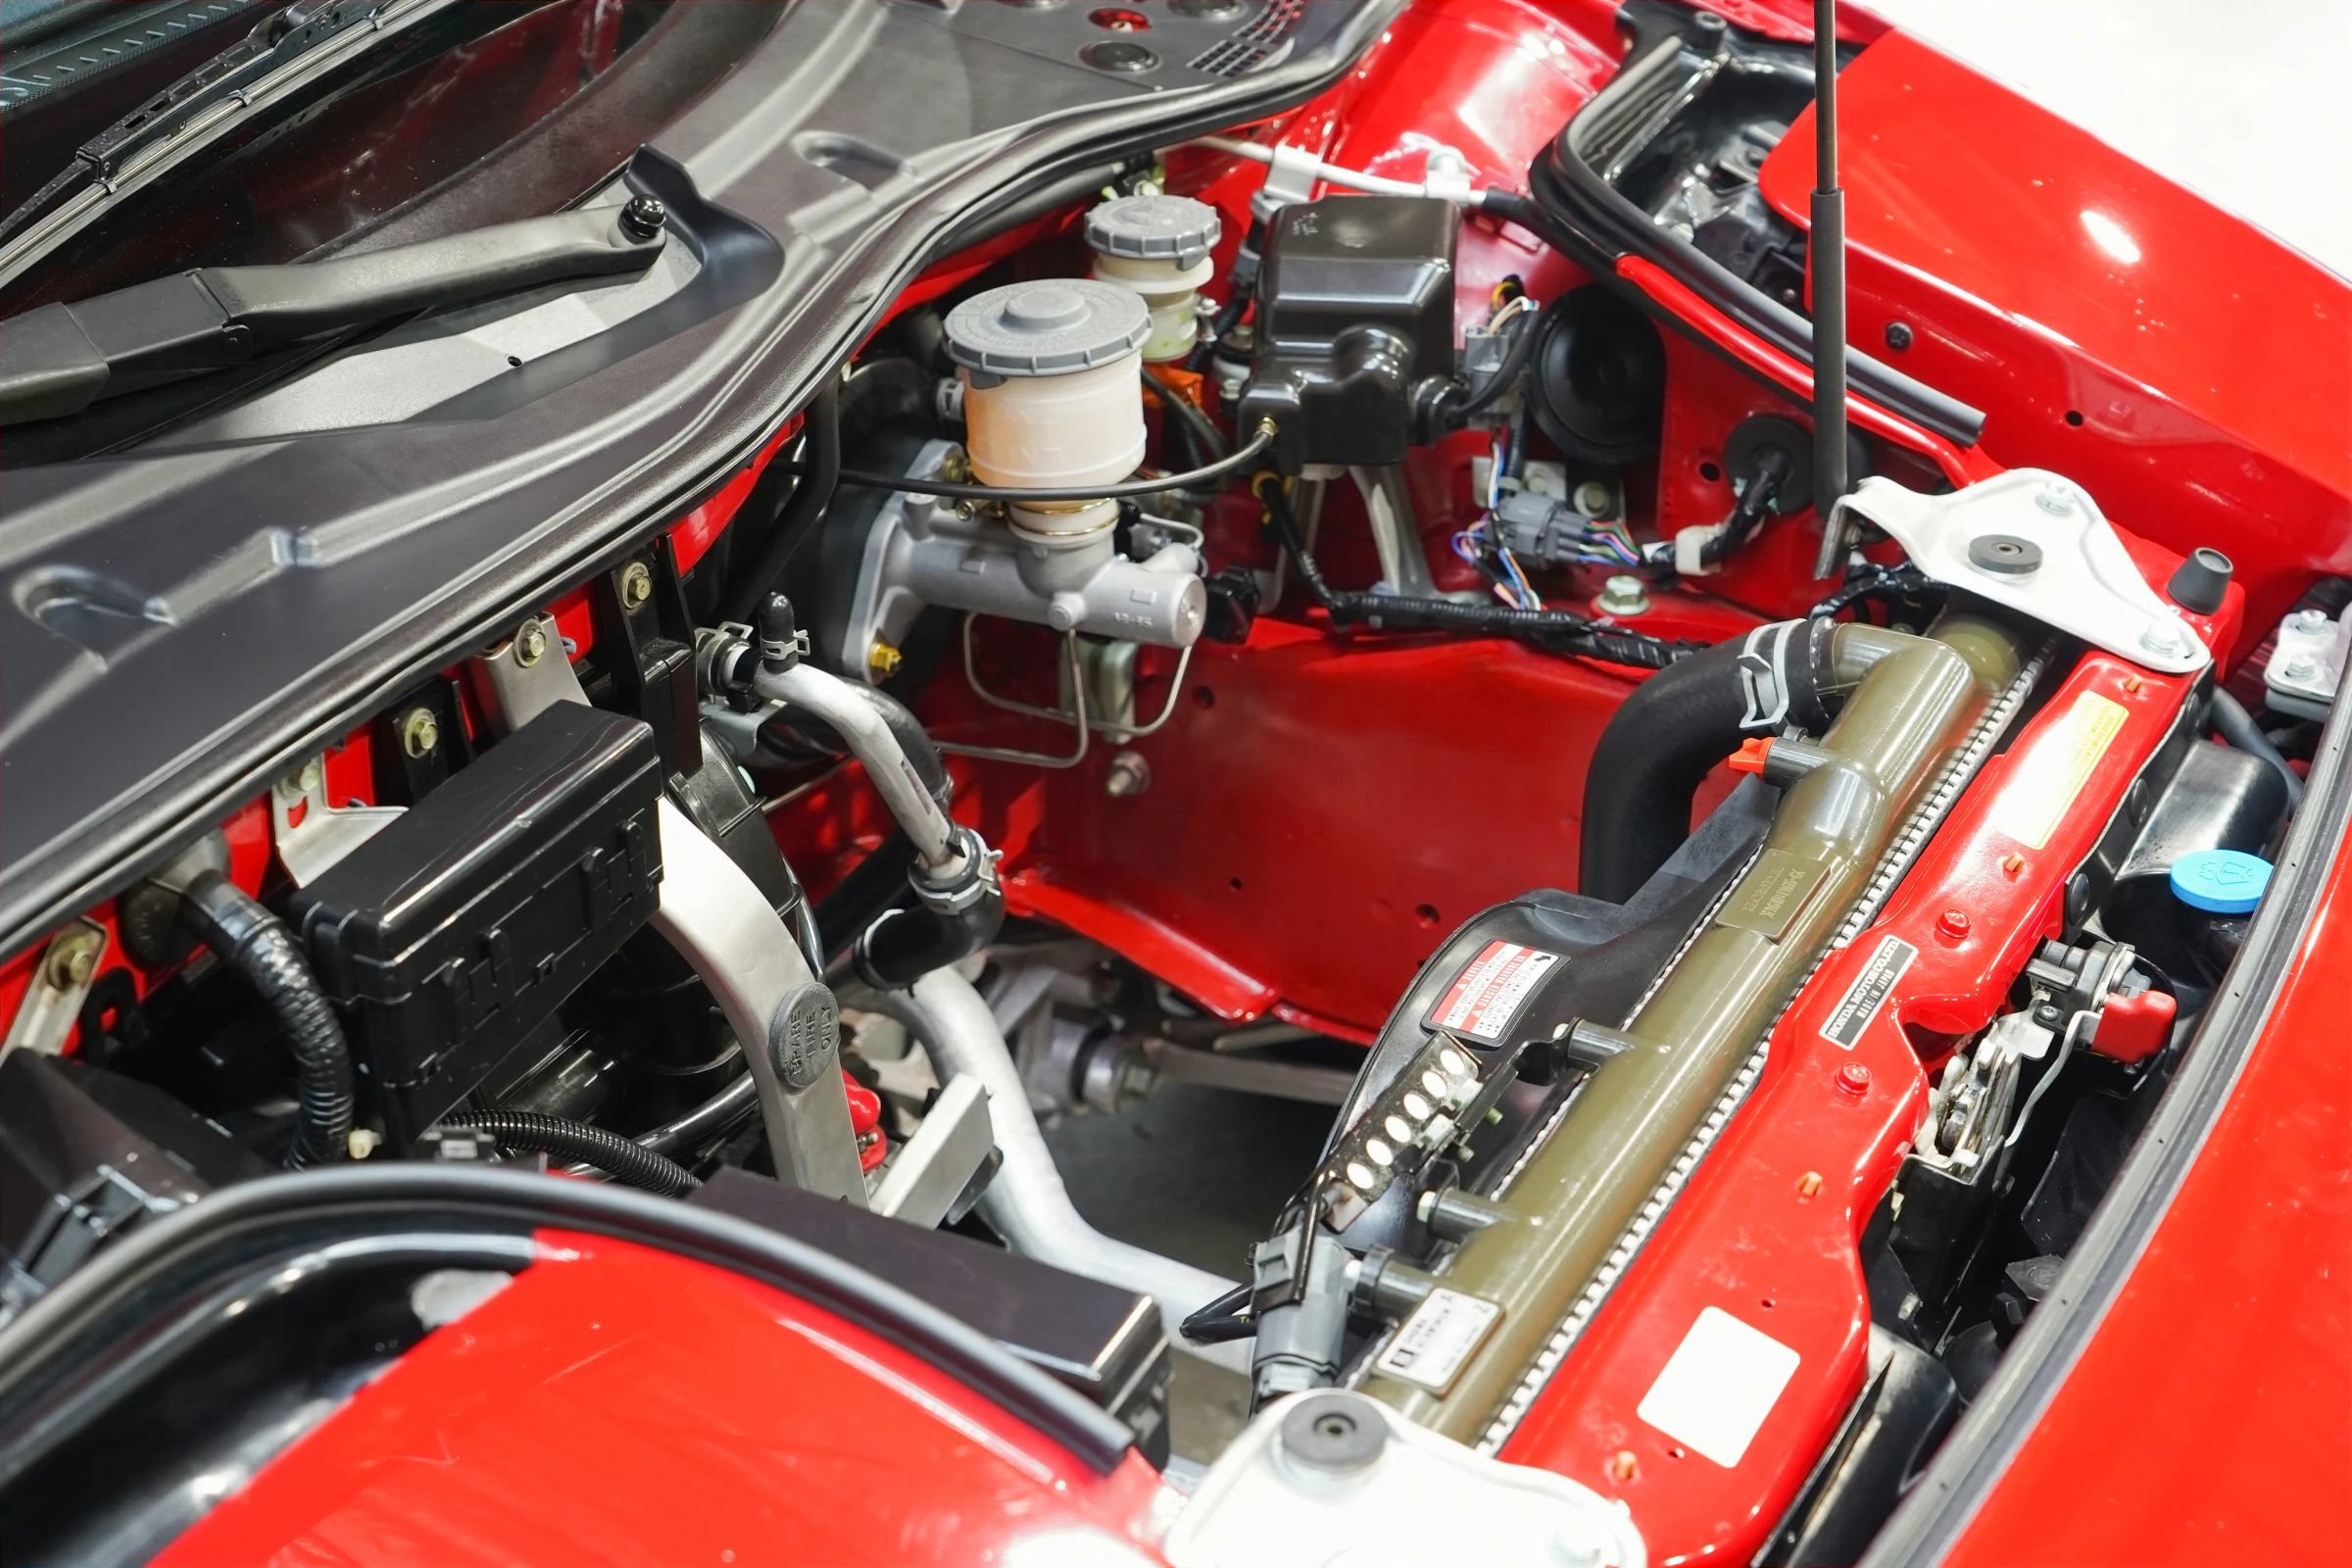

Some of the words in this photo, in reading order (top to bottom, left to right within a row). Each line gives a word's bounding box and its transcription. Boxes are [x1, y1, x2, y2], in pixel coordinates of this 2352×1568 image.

[1828, 1004, 1858, 1039] HONDA
[1850, 969, 1881, 1005] MOTOR
[1856, 999, 1876, 1019] MADE
[1870, 989, 1882, 1000] IN
[1876, 968, 1895, 990] JAPAN
[806, 1010, 816, 1059] TIRE
[820, 1006, 832, 1052] ONLY
